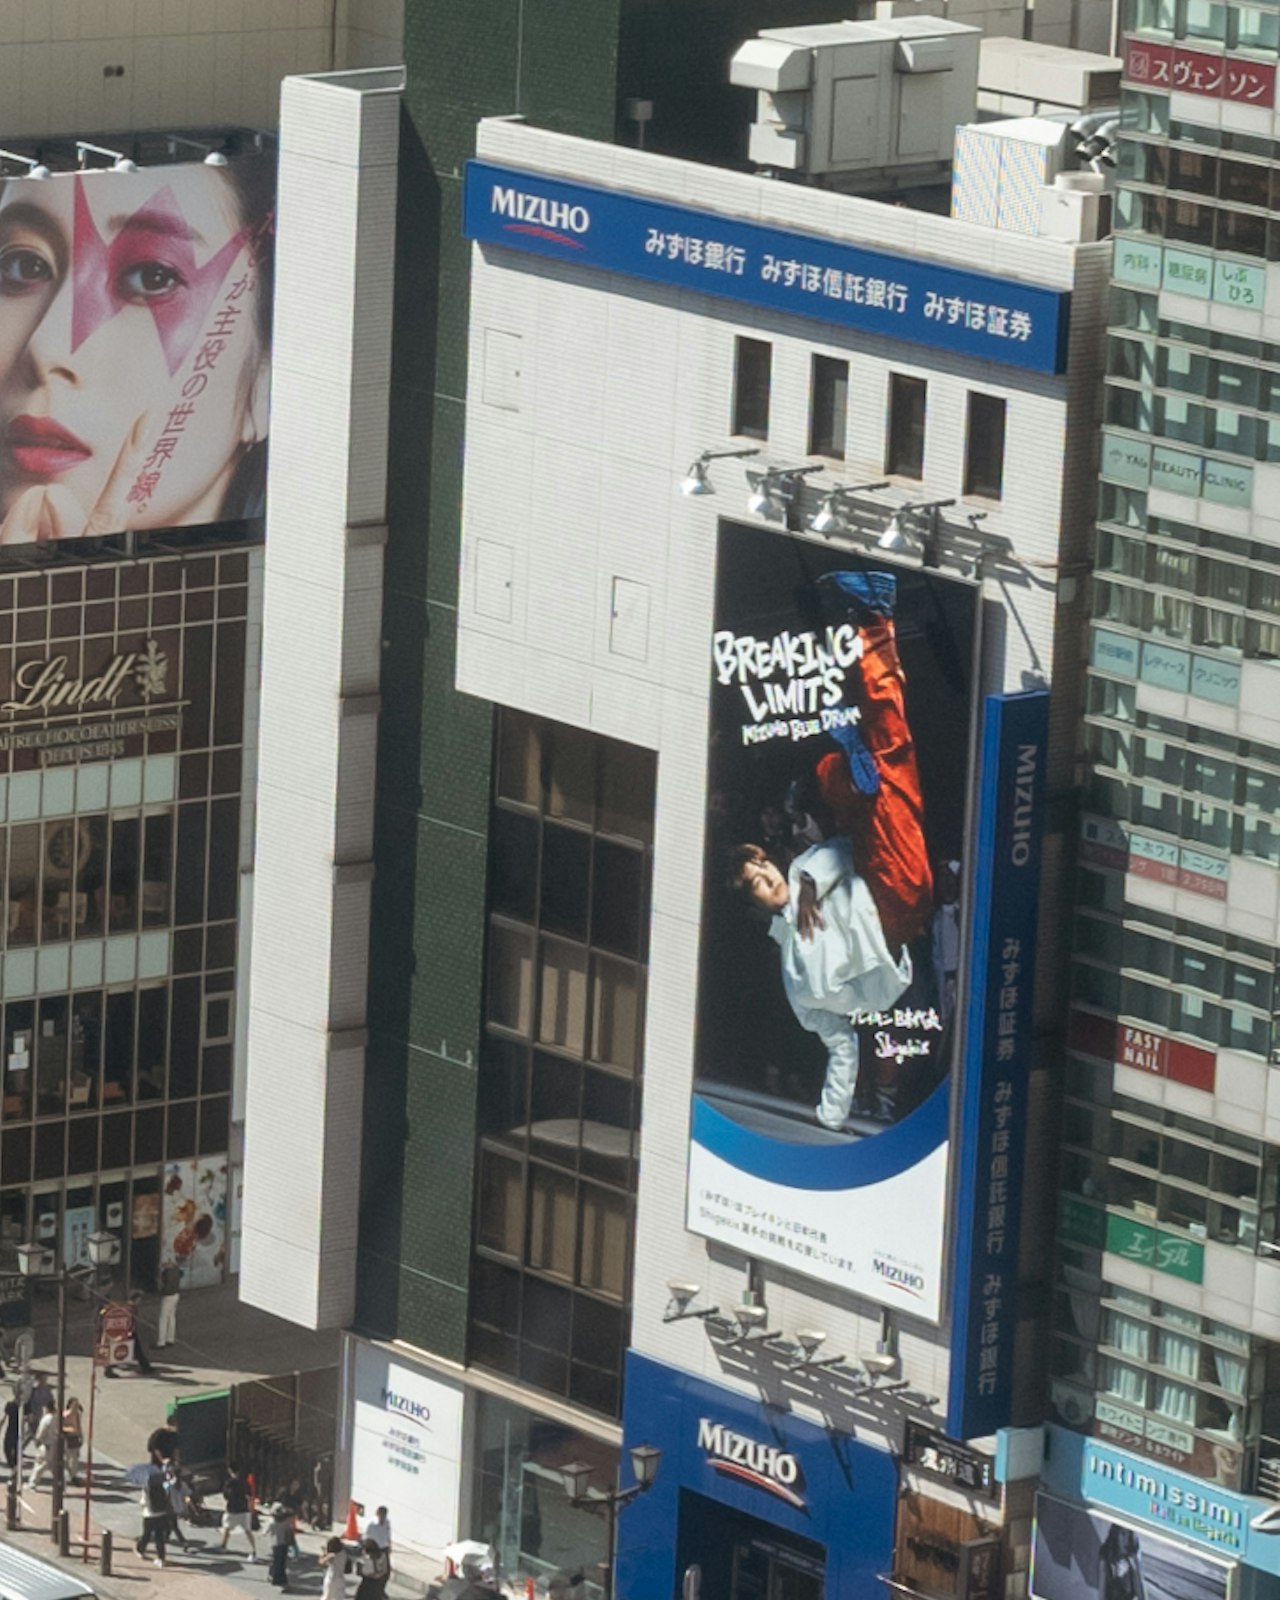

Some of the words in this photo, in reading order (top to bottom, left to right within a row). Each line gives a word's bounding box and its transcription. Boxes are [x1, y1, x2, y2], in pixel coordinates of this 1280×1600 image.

[1152, 60, 1267, 99] スヴェンソン
[491, 185, 591, 235] MIZUHO
[644, 228, 747, 277] みずほ銀行
[760, 254, 909, 313] みずほ信託銀行
[922, 290, 1033, 342] みずほ証券
[0, 652, 136, 712] Lindt
[712, 623, 864, 685] BREAKING
[740, 667, 845, 722] LIMITS
[1011, 743, 1038, 867] MIZUHO
[995, 936, 1024, 1062] みずほ証券
[1123, 1044, 1160, 1071] NAIL
[1124, 1028, 1160, 1055] FAST
[872, 1258, 925, 1291] MIZUHO
[977, 1274, 1003, 1397] みずほ銀行
[379, 1387, 431, 1422] MIZUHO
[697, 1418, 797, 1484] MIZUHO
[1090, 1453, 1243, 1531] intimissimi
